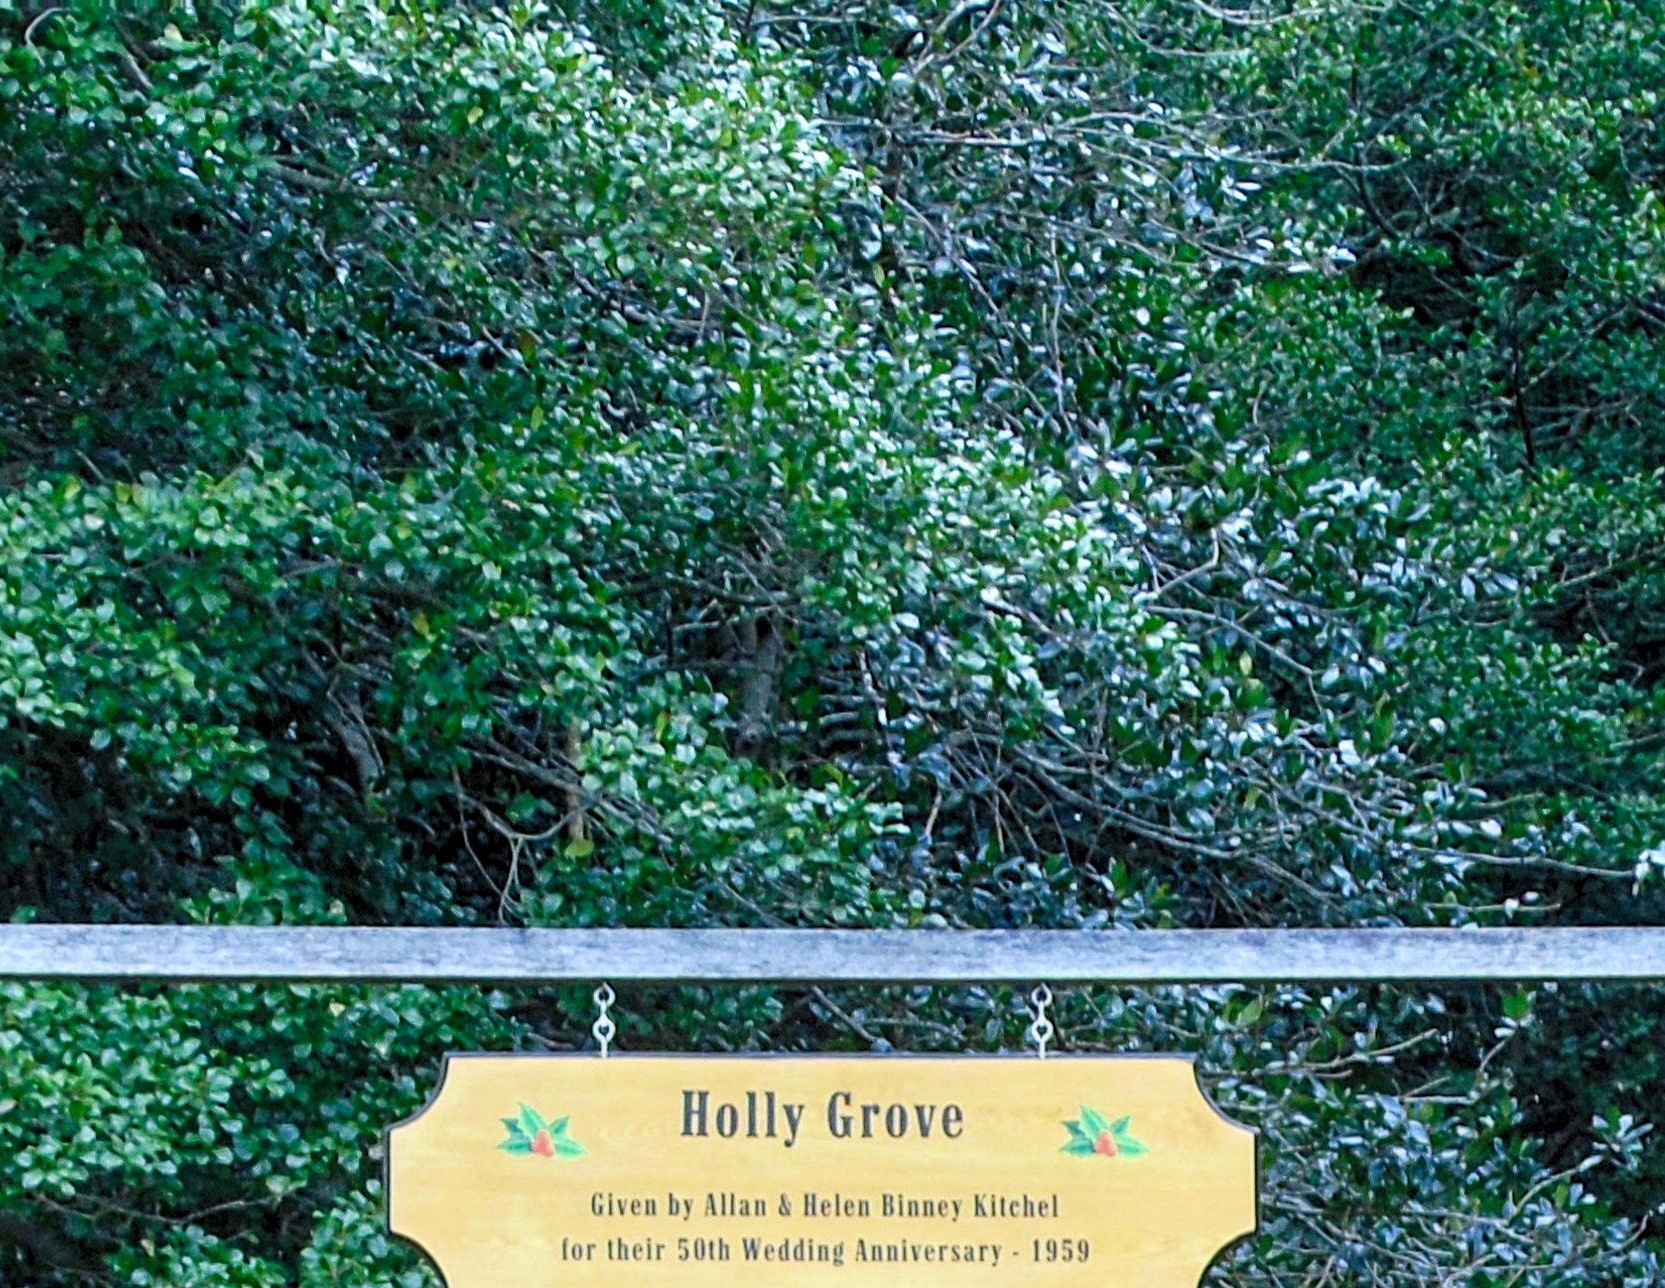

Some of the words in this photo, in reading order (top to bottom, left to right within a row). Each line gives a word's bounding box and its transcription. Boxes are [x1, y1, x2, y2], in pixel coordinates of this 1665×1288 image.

[680, 1089, 805, 1148] Holly
[826, 1091, 965, 1140] Grove
[590, 1191, 658, 1217] Given
[668, 1191, 695, 1222] by
[704, 1192, 767, 1217] Allan
[777, 1193, 792, 1217] &
[803, 1192, 871, 1218] Helen
[881, 1193, 963, 1223] Binney
[973, 1193, 1060, 1219] Kitchel
[561, 1237, 597, 1261] for
[607, 1237, 667, 1261] their
[677, 1237, 731, 1261] 50th
[741, 1237, 845, 1266] Wedding
[854, 1238, 1003, 1267] Anniversary
[1032, 1238, 1091, 1262] 1959
